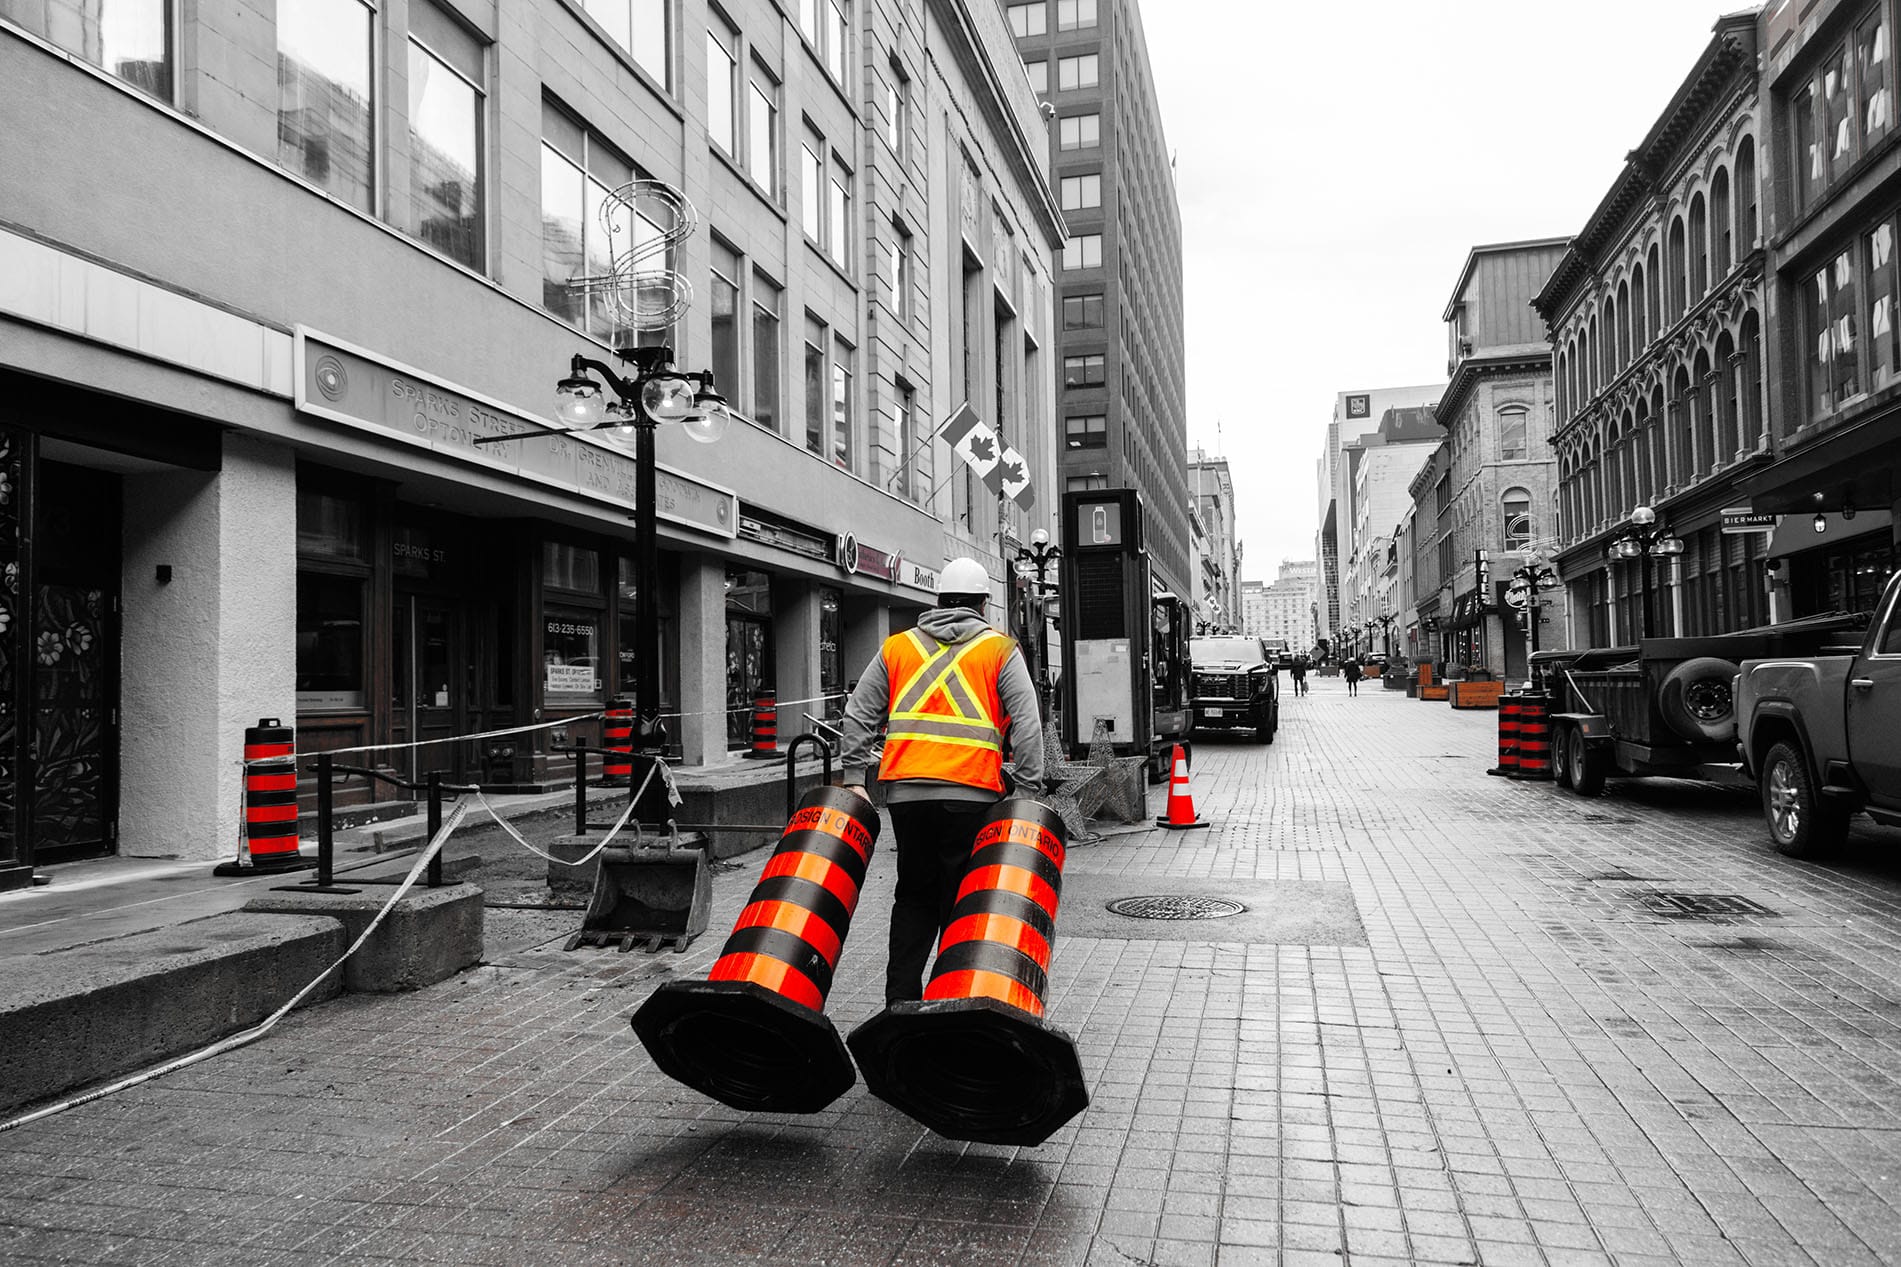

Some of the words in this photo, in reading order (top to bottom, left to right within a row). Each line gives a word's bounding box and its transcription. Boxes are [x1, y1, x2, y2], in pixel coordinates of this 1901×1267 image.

[391, 377, 460, 418] SPARKS
[469, 405, 528, 442] STREET
[414, 411, 511, 459] OPTOMETRY
[549, 435, 571, 457] DR.
[393, 543, 431, 561] SPARKS
[914, 566, 935, 589] Booth
[1008, 824, 1059, 857] ONTARIO
